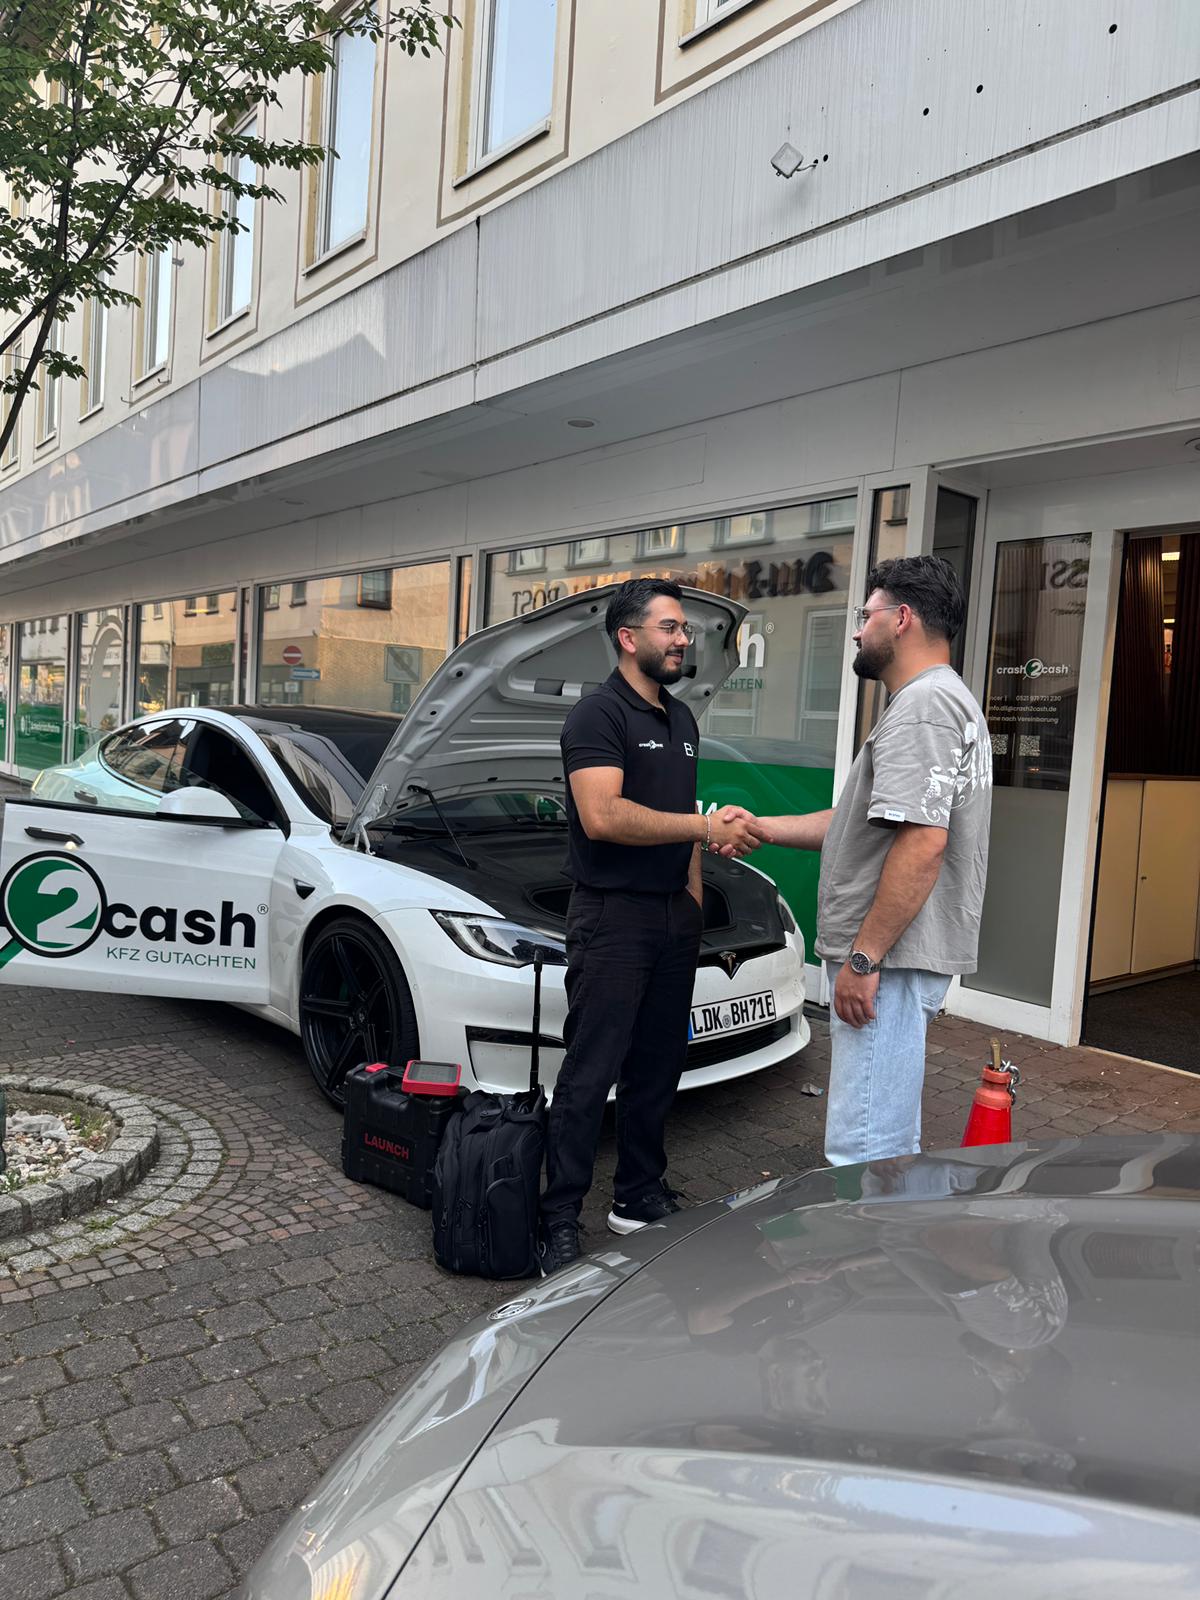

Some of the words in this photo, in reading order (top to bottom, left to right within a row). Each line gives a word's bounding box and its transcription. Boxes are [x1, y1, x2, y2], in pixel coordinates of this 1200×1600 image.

[722, 677, 763, 690] CHTEN
[106, 946, 140, 961] KFZ
[145, 950, 257, 970] GUTACHTEN
[691, 1005, 723, 1035] LDK
[364, 1132, 410, 1160] LAUNCH
